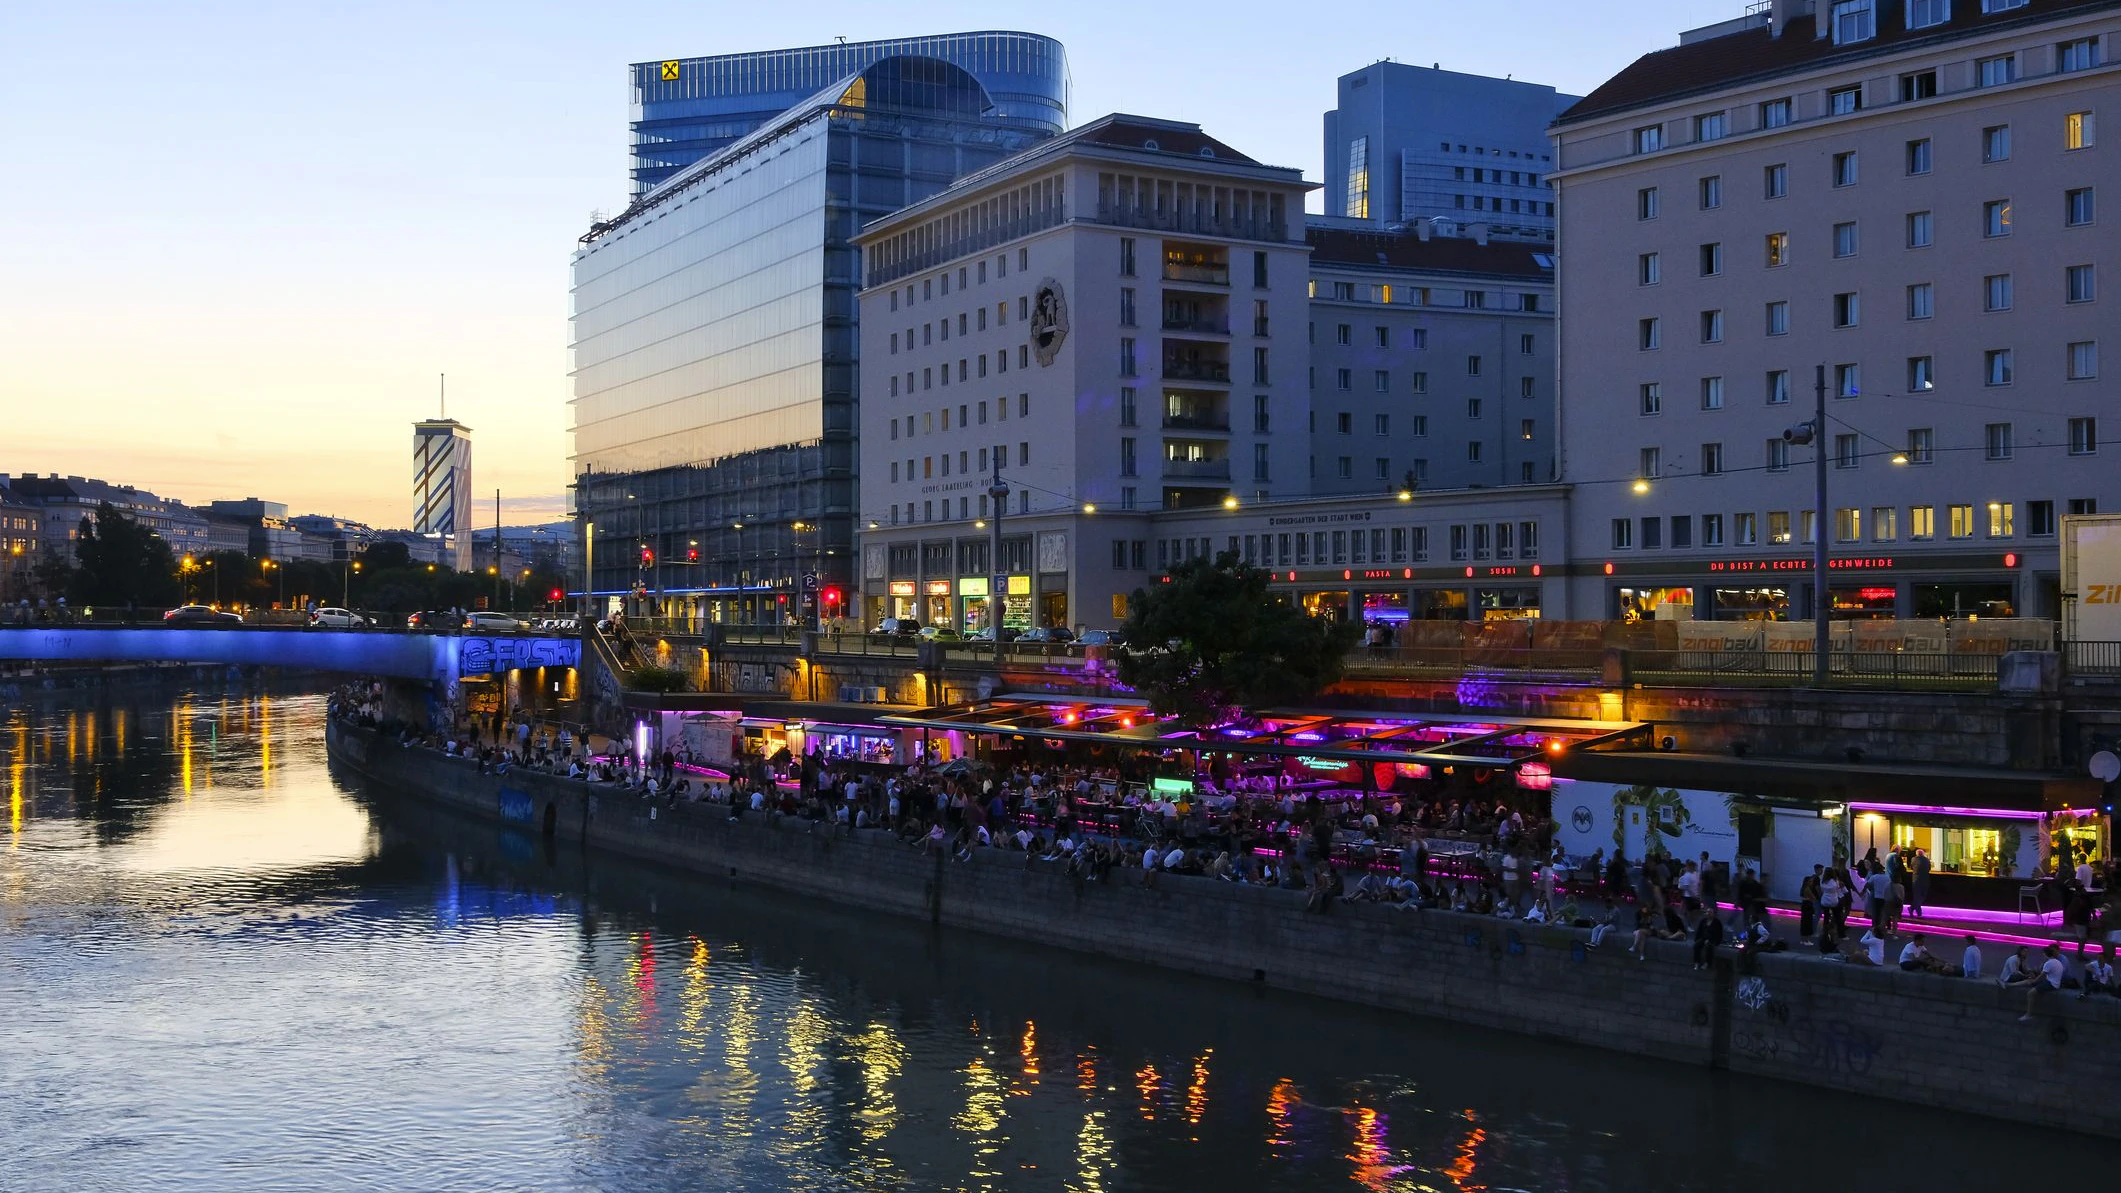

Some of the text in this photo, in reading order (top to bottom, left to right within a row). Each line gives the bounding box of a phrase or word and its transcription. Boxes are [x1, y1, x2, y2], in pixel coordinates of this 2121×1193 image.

[1710, 558, 1893, 571] DU BIST A ECHTE GENWEIDE
[1365, 570, 1391, 578] PASTA
[1489, 567, 1516, 575] SUSHI
